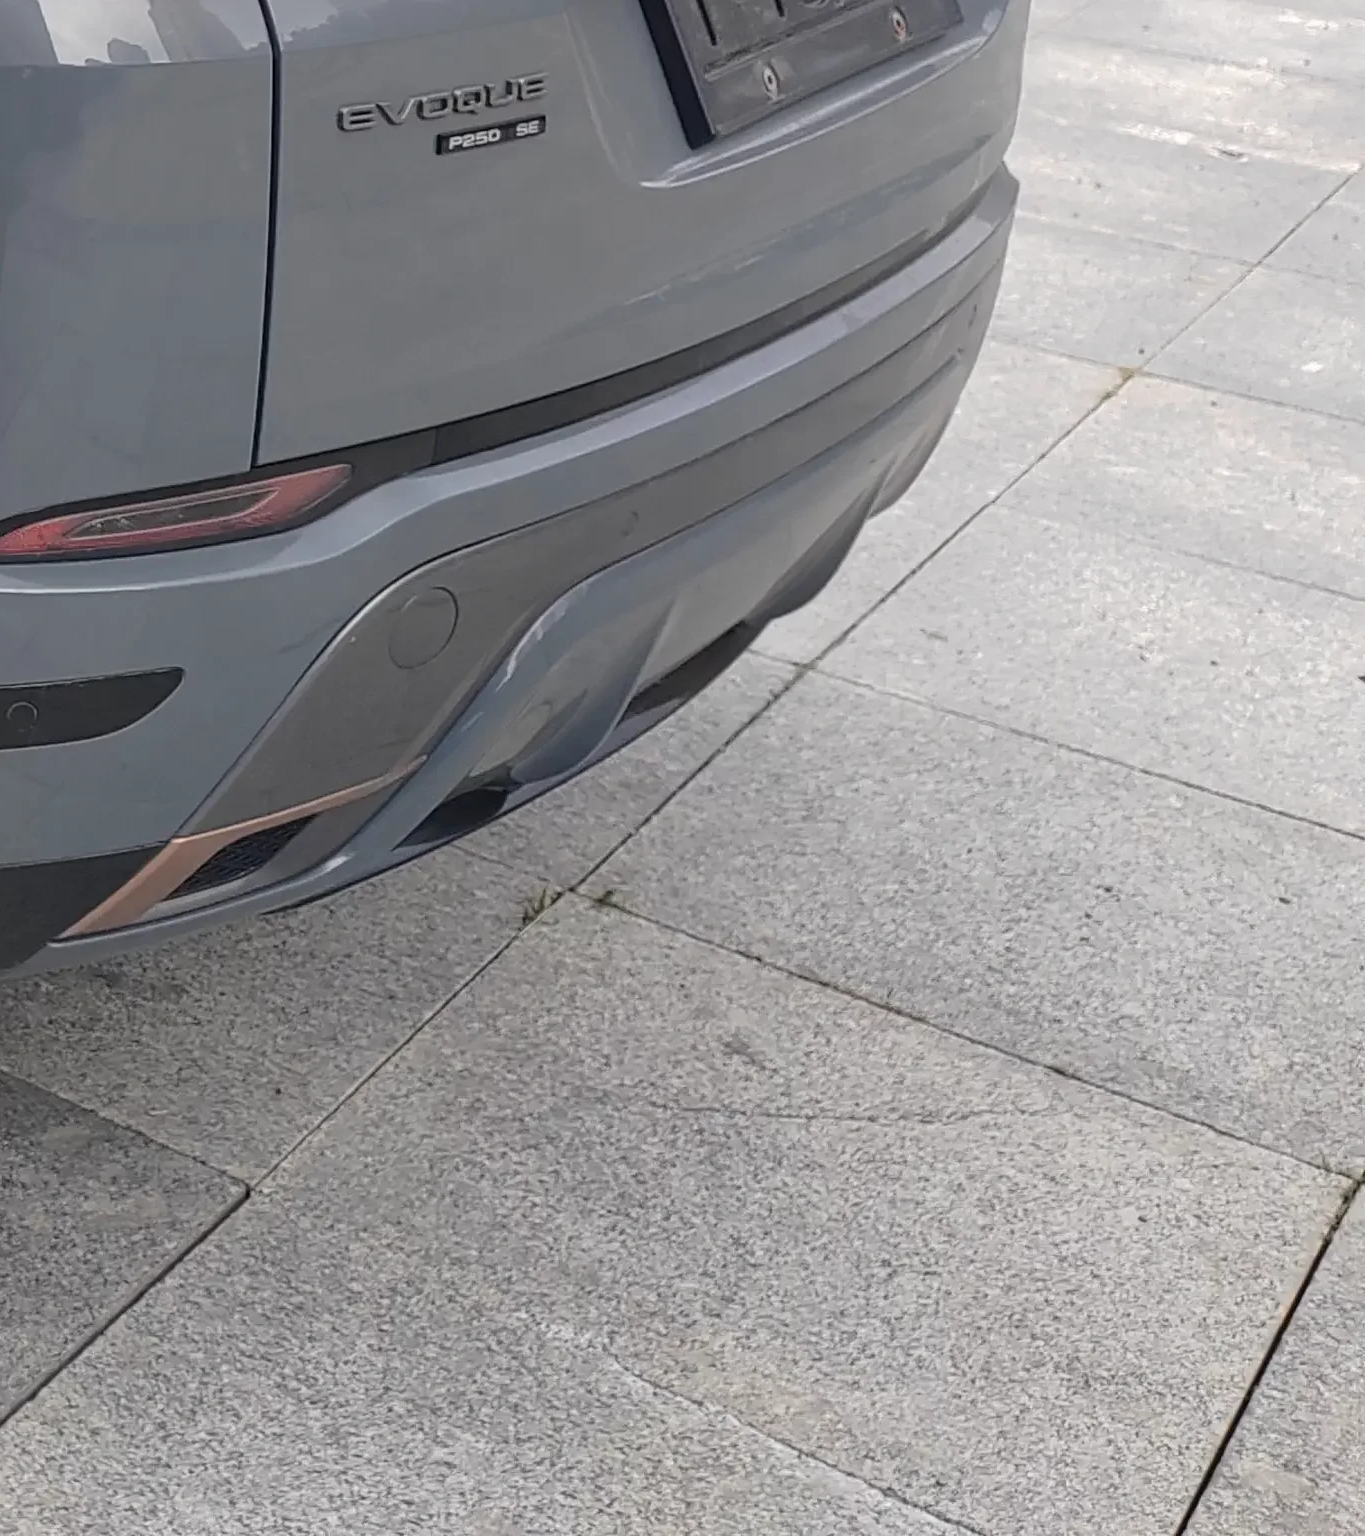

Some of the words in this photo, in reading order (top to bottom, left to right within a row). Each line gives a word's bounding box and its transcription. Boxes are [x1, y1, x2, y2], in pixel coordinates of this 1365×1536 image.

[336, 71, 549, 133] EVOQUE
[448, 128, 502, 151] P250
[515, 119, 540, 137] SE
